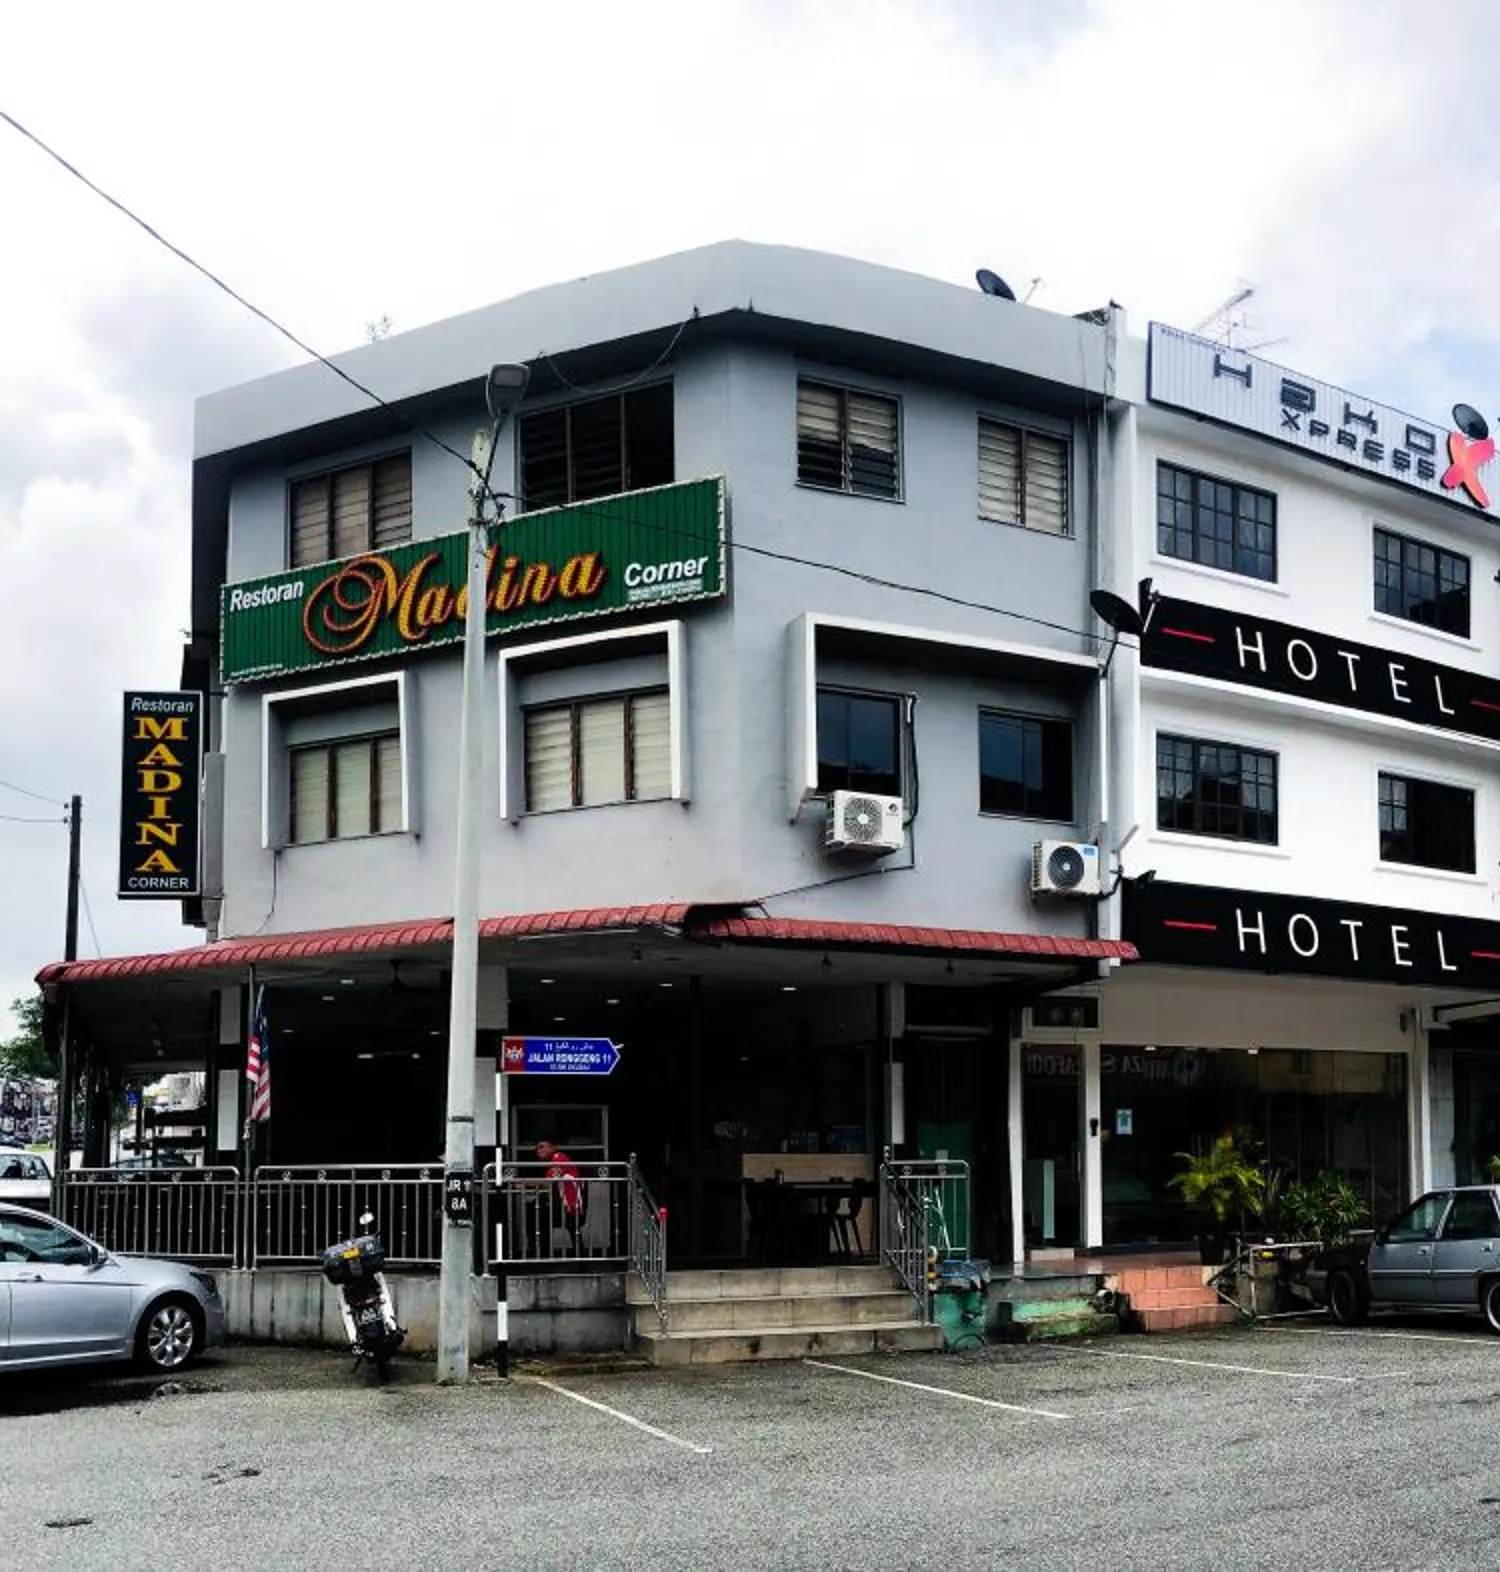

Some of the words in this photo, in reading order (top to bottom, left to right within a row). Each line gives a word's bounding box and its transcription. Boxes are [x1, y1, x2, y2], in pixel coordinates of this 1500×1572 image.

[1280, 407, 1436, 480] XPRESS
[229, 580, 304, 612] Restoran
[624, 556, 709, 587] Corner
[1235, 627, 1455, 715] HOTEL
[131, 697, 194, 713] Restoran
[133, 716, 189, 873] MADINA
[128, 876, 190, 889] CORNER
[1235, 908, 1457, 971] HOTEL
[527, 1053, 555, 1063] JALAN
[602, 1053, 612, 1064] 11
[451, 1197, 468, 1210] 8A
